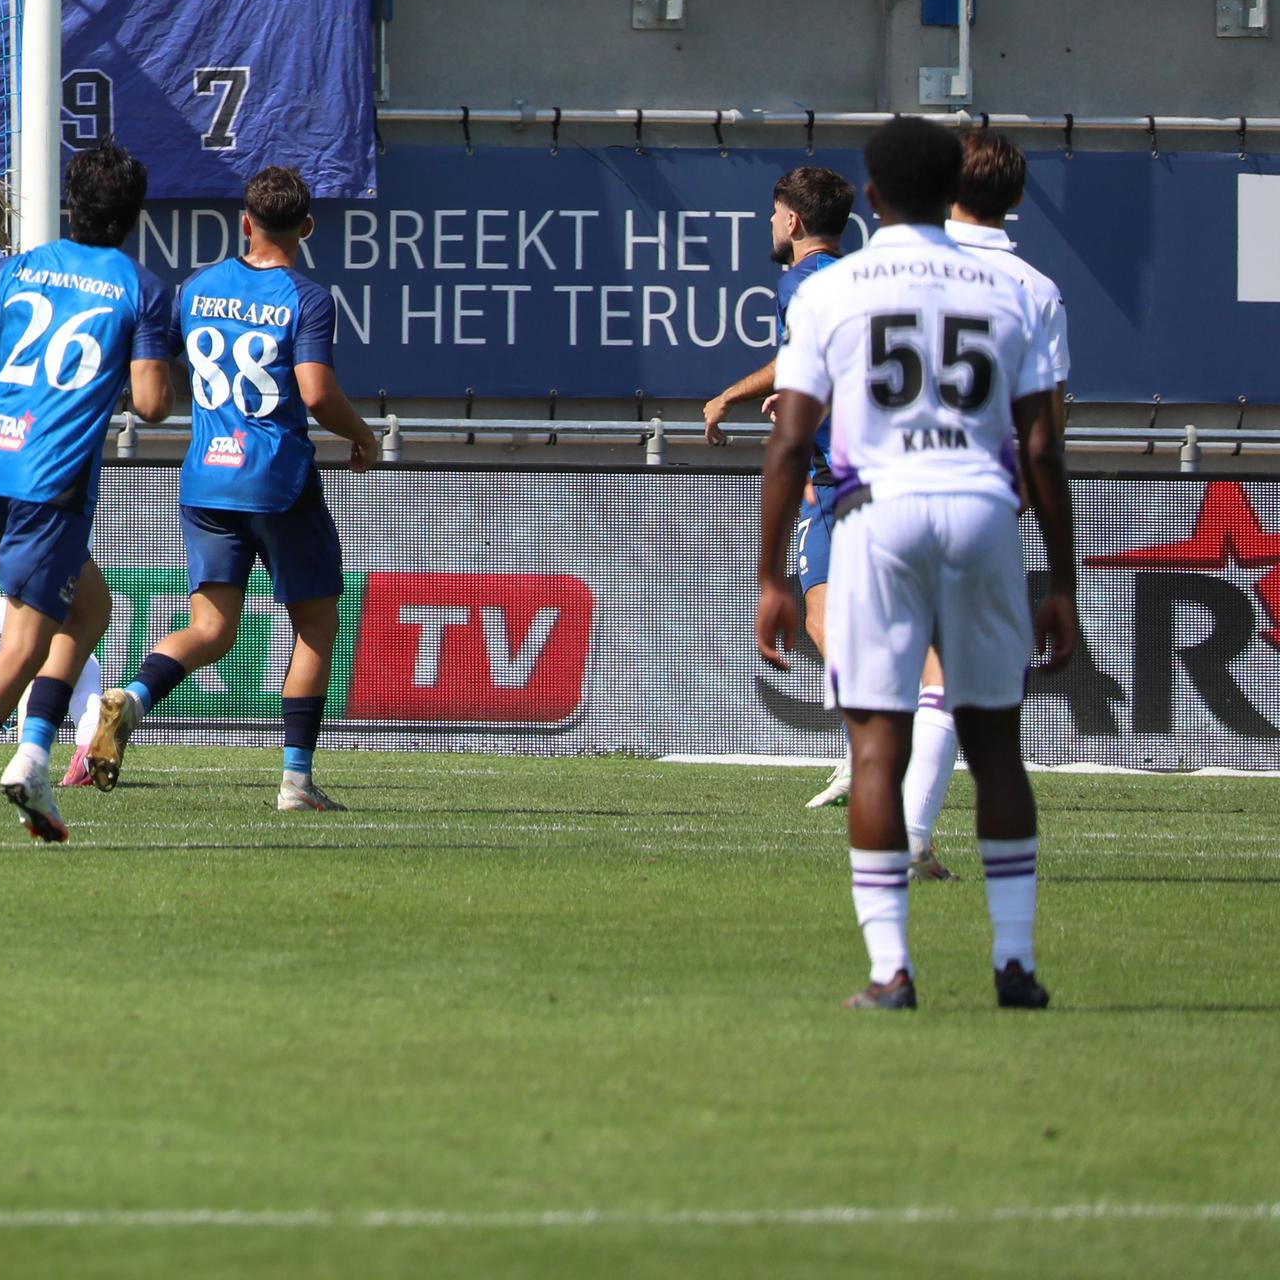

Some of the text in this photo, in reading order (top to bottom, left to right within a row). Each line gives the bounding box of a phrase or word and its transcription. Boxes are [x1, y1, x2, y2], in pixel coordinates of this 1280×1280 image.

[345, 210, 600, 271] BREEKT
[625, 210, 756, 272] HET
[852, 261, 995, 288] NAPOLEON
[190, 295, 290, 328] FERRARO
[401, 285, 531, 346] HET
[553, 286, 777, 348] TERUG
[187, 326, 280, 418] 88
[867, 308, 998, 414] 55
[902, 428, 969, 453] KANA
[397, 604, 560, 689] TV
